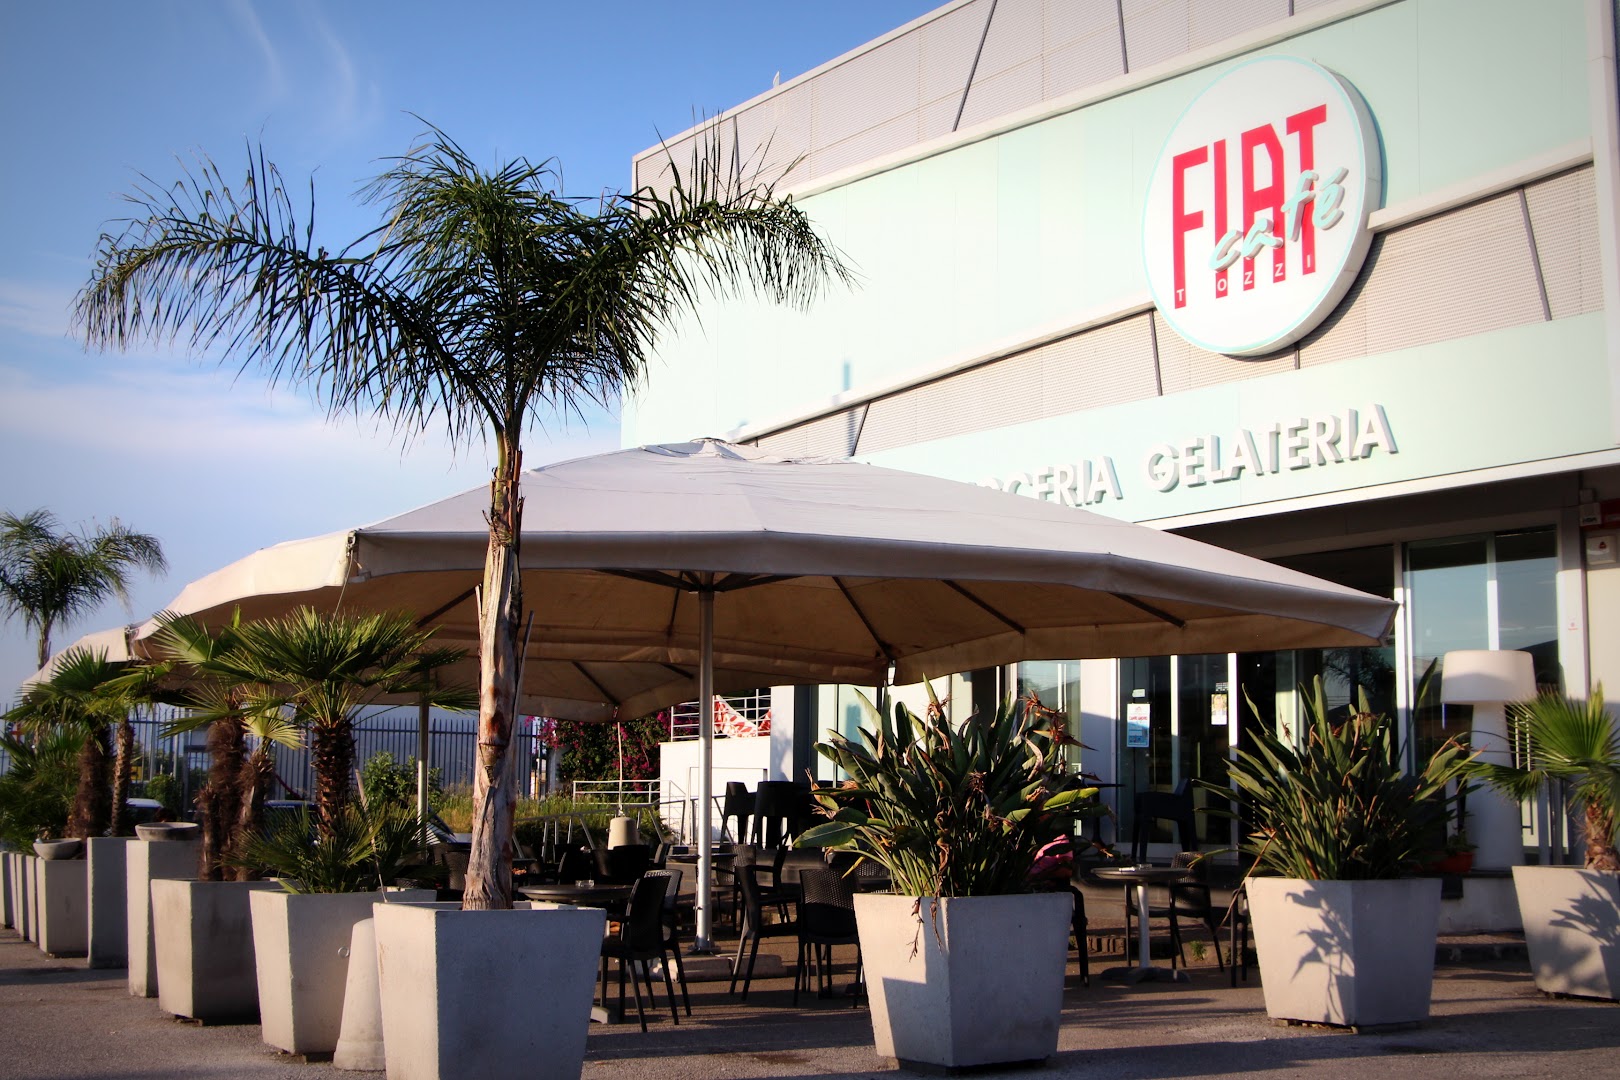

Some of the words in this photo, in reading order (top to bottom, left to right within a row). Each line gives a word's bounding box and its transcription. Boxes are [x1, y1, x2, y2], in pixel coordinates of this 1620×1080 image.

[1172, 103, 1327, 309] FIAT
[1209, 167, 1349, 272] café
[1176, 253, 1312, 303] TOZZI
[1144, 403, 1399, 494] GELATERIA
